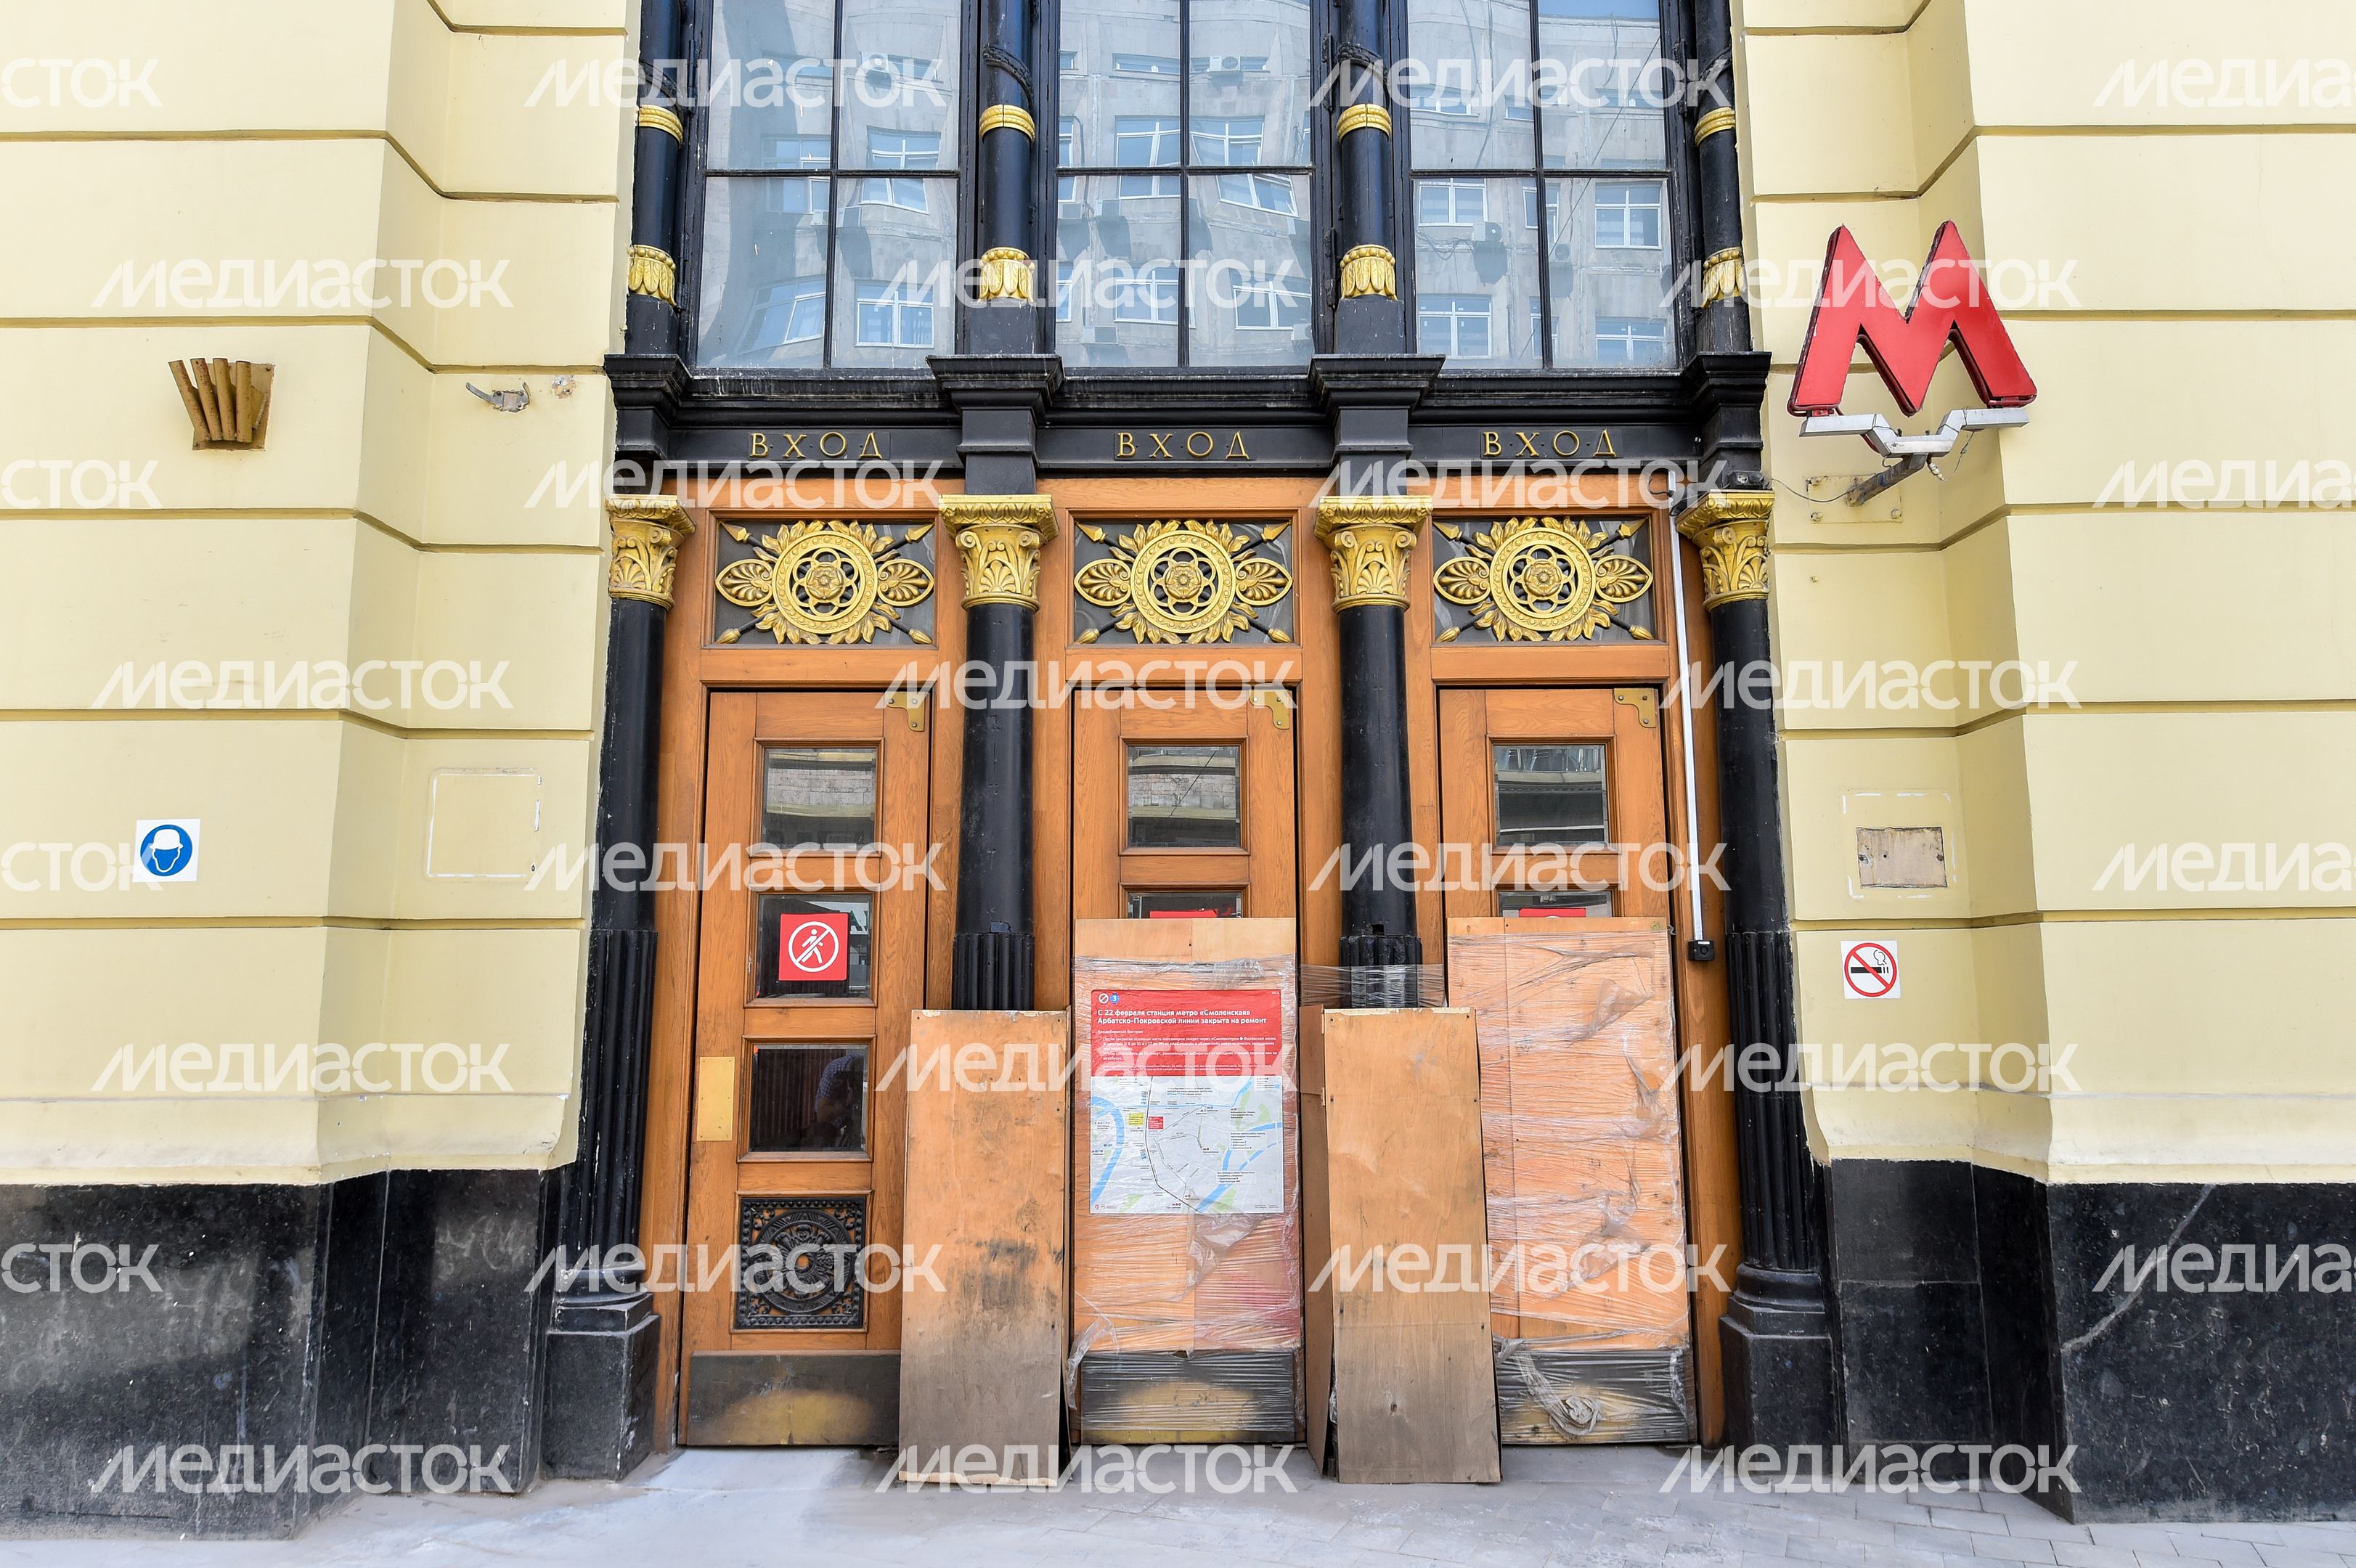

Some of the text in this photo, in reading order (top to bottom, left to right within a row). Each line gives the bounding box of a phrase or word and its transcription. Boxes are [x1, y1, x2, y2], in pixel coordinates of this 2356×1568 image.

[750, 431, 883, 459] ВХОД
[1117, 430, 1250, 460] ВХОД
[1483, 429, 1617, 458] ВХОД
